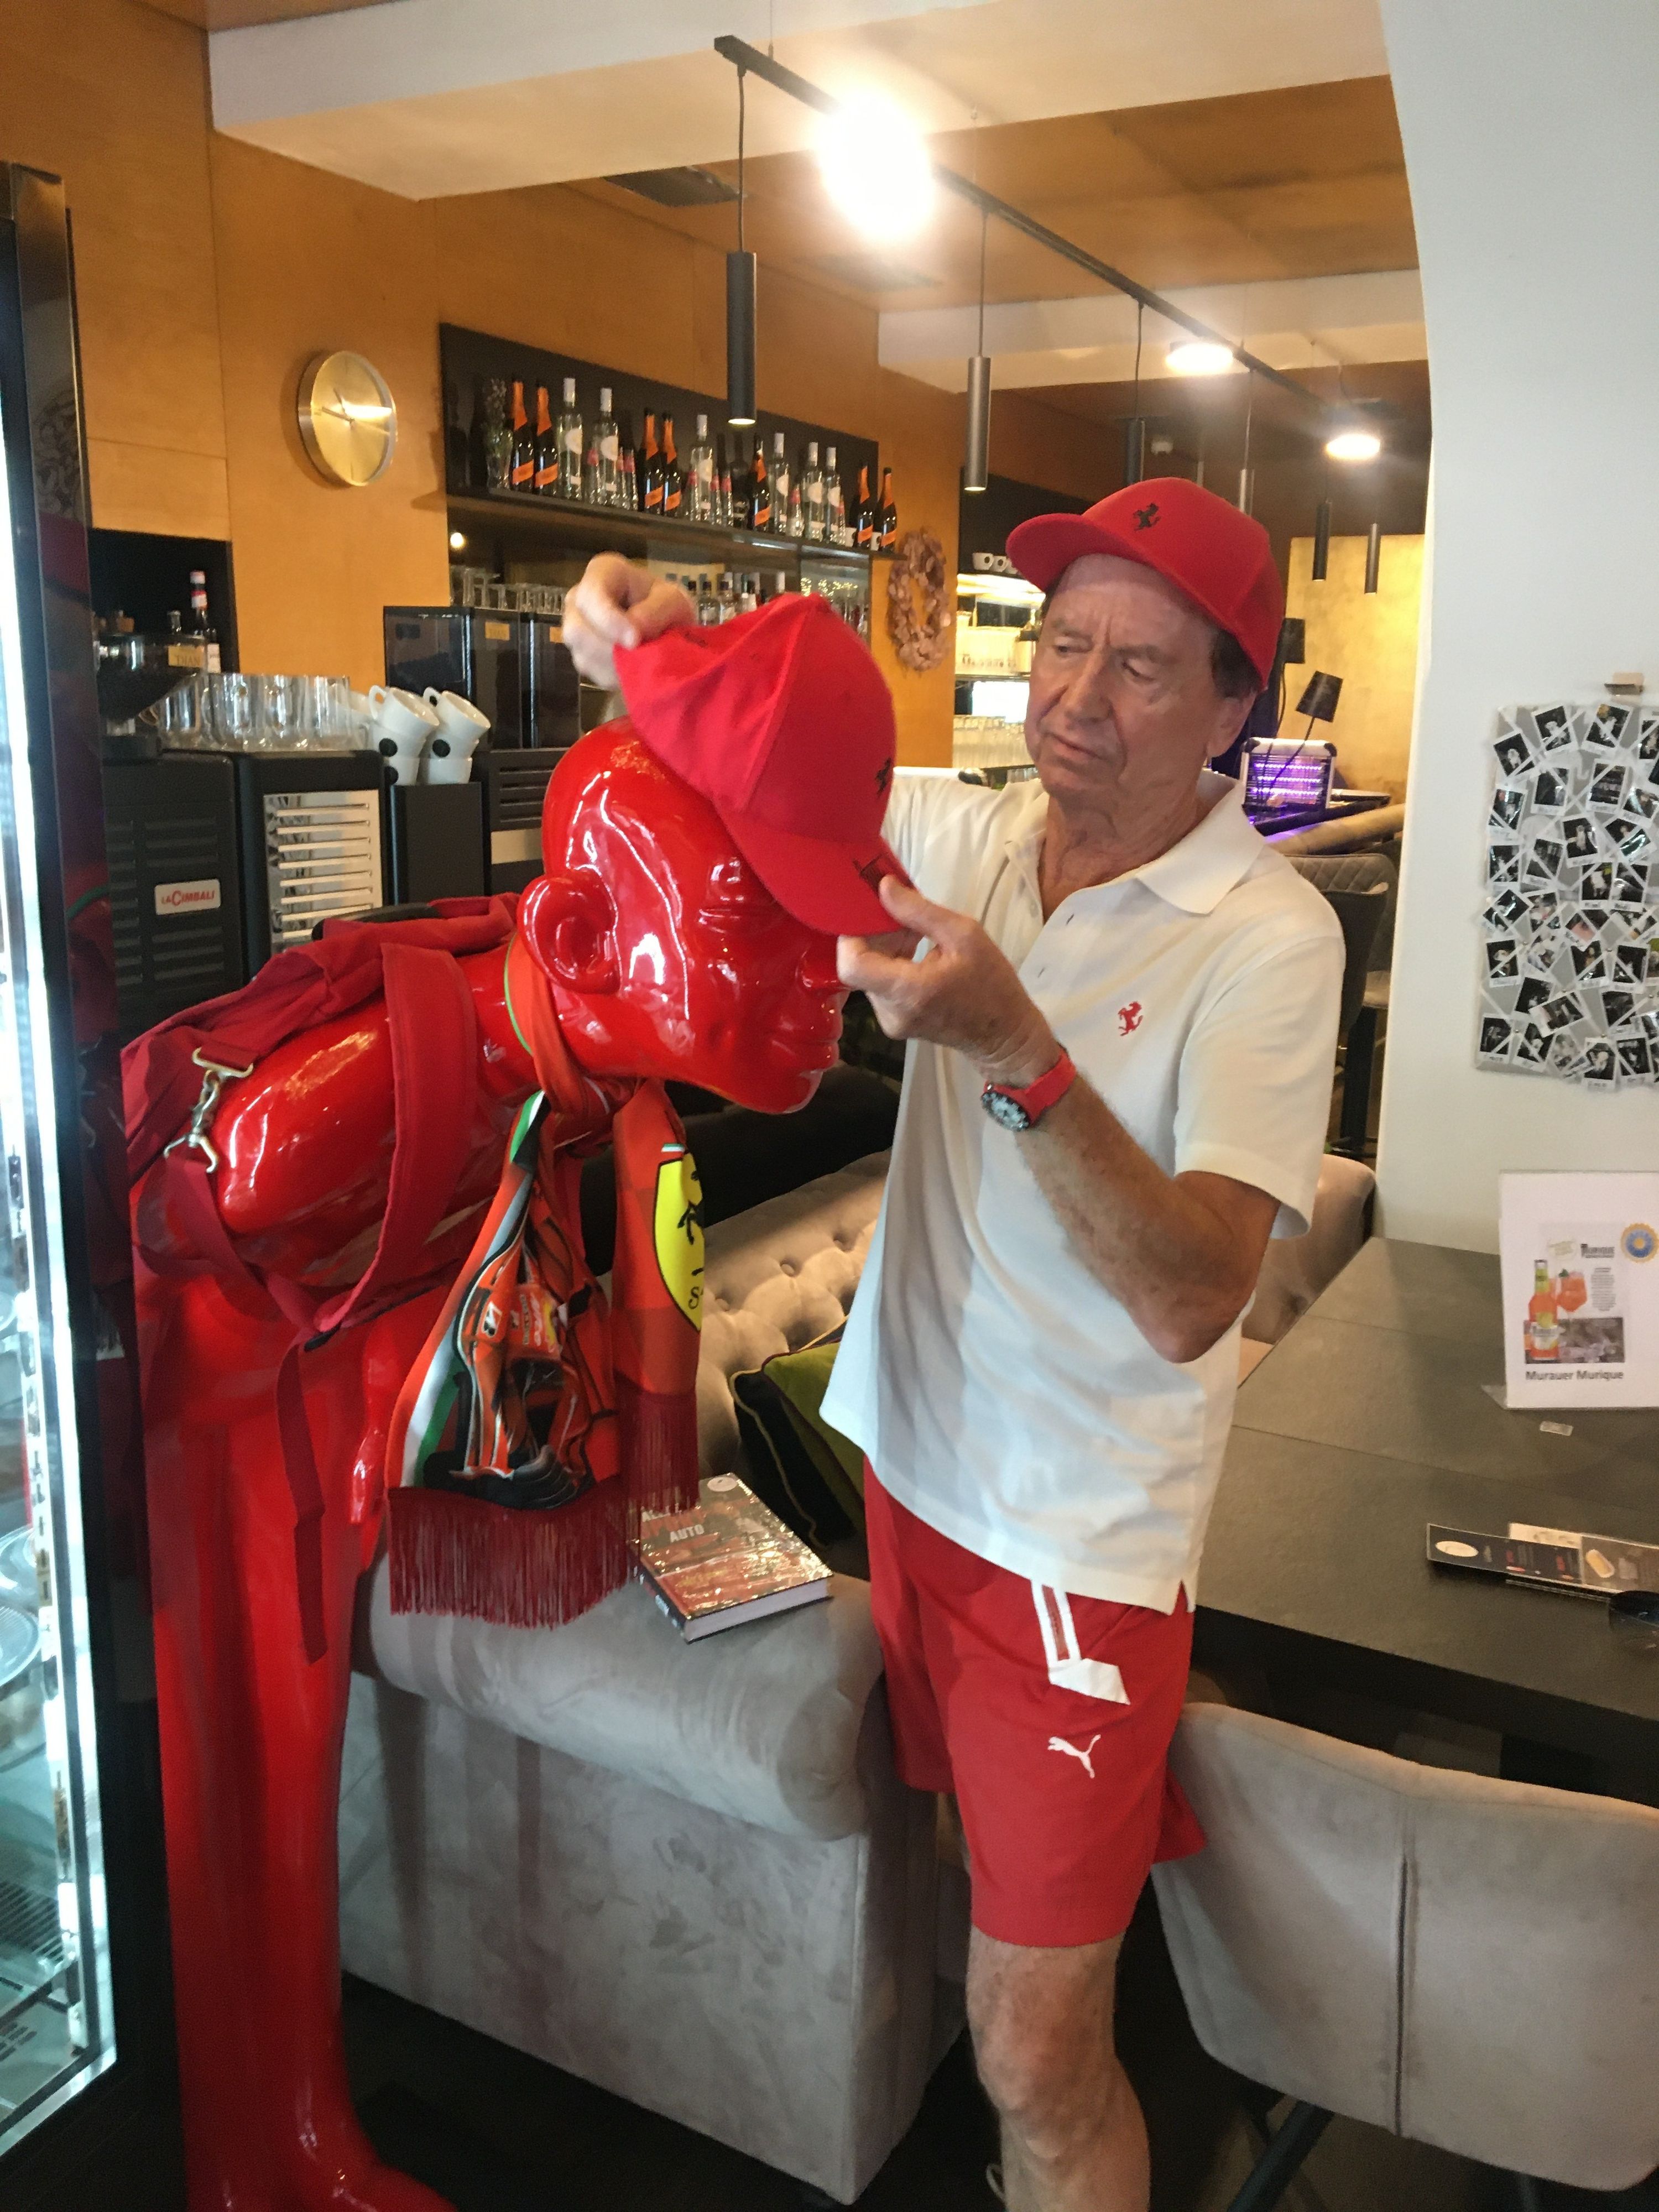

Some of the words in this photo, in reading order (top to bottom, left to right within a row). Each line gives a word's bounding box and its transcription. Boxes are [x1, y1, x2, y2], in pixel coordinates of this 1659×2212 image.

[1526, 1371, 1574, 1380] Murauer
[1577, 1370, 1624, 1381] Murique
[670, 1524, 705, 1543] AUTO
